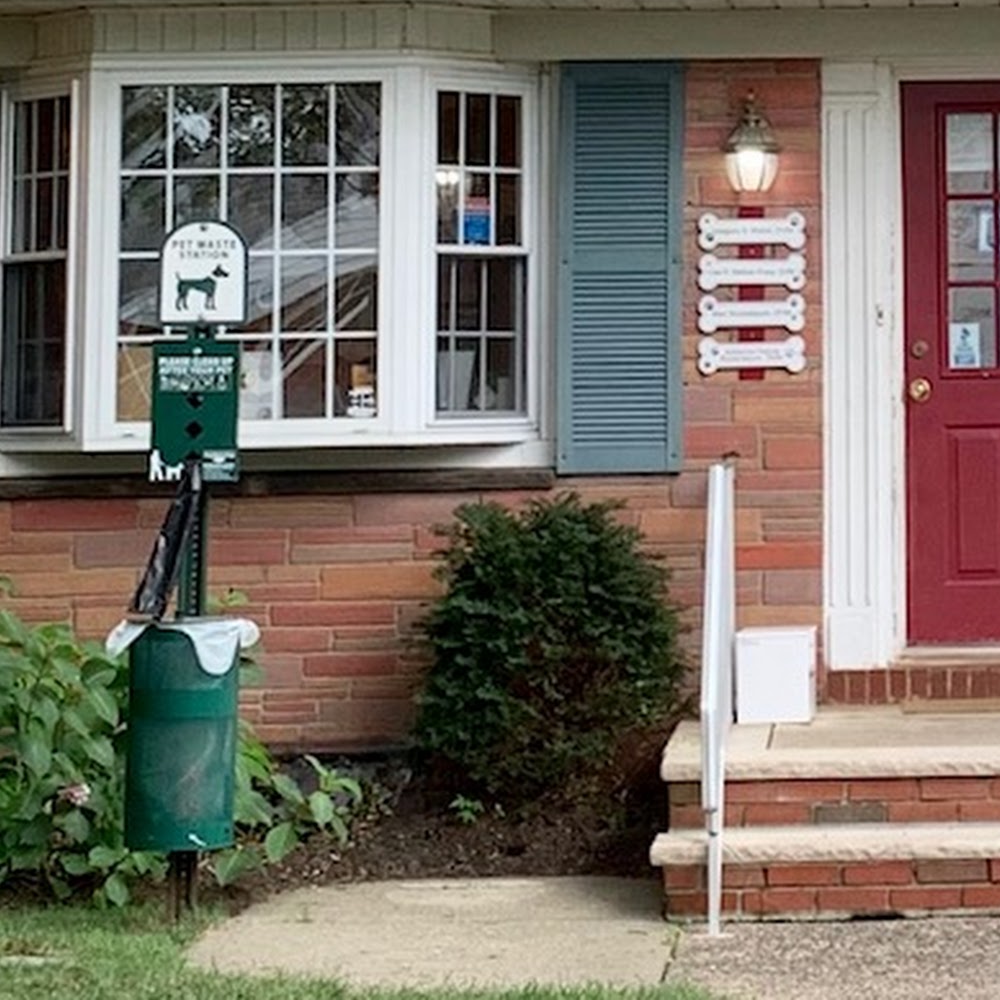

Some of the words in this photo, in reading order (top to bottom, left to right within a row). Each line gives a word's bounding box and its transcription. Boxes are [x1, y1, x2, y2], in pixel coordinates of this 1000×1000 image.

[172, 240, 193, 249] PET
[197, 240, 237, 249] WASTE
[180, 250, 229, 259] STATION
